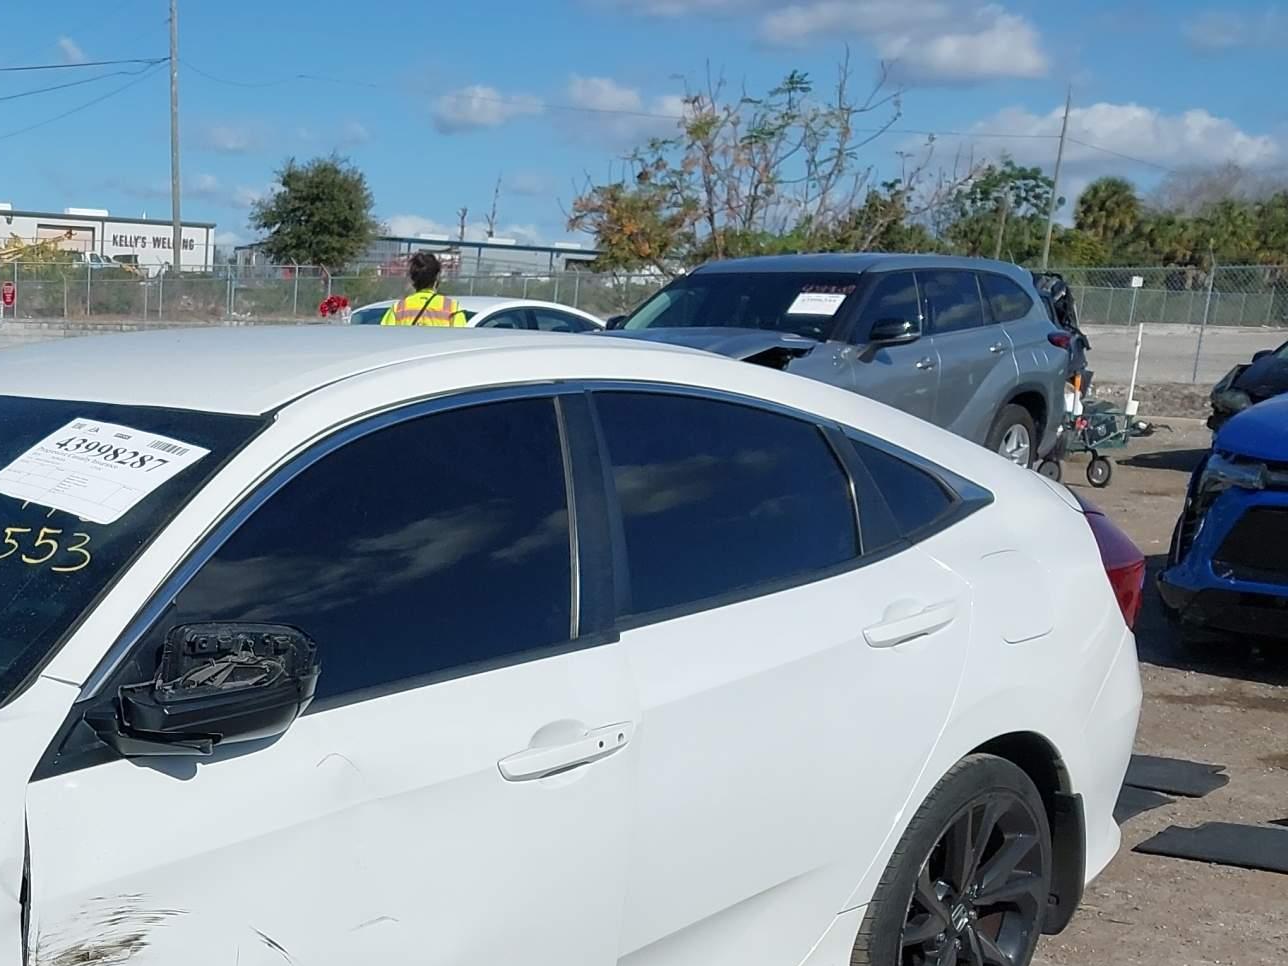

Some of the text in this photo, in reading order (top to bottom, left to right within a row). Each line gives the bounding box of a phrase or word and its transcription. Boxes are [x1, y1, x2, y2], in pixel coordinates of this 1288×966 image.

[112, 233, 195, 250] KELLY'S WELNG
[55, 436, 170, 472] 43998287
